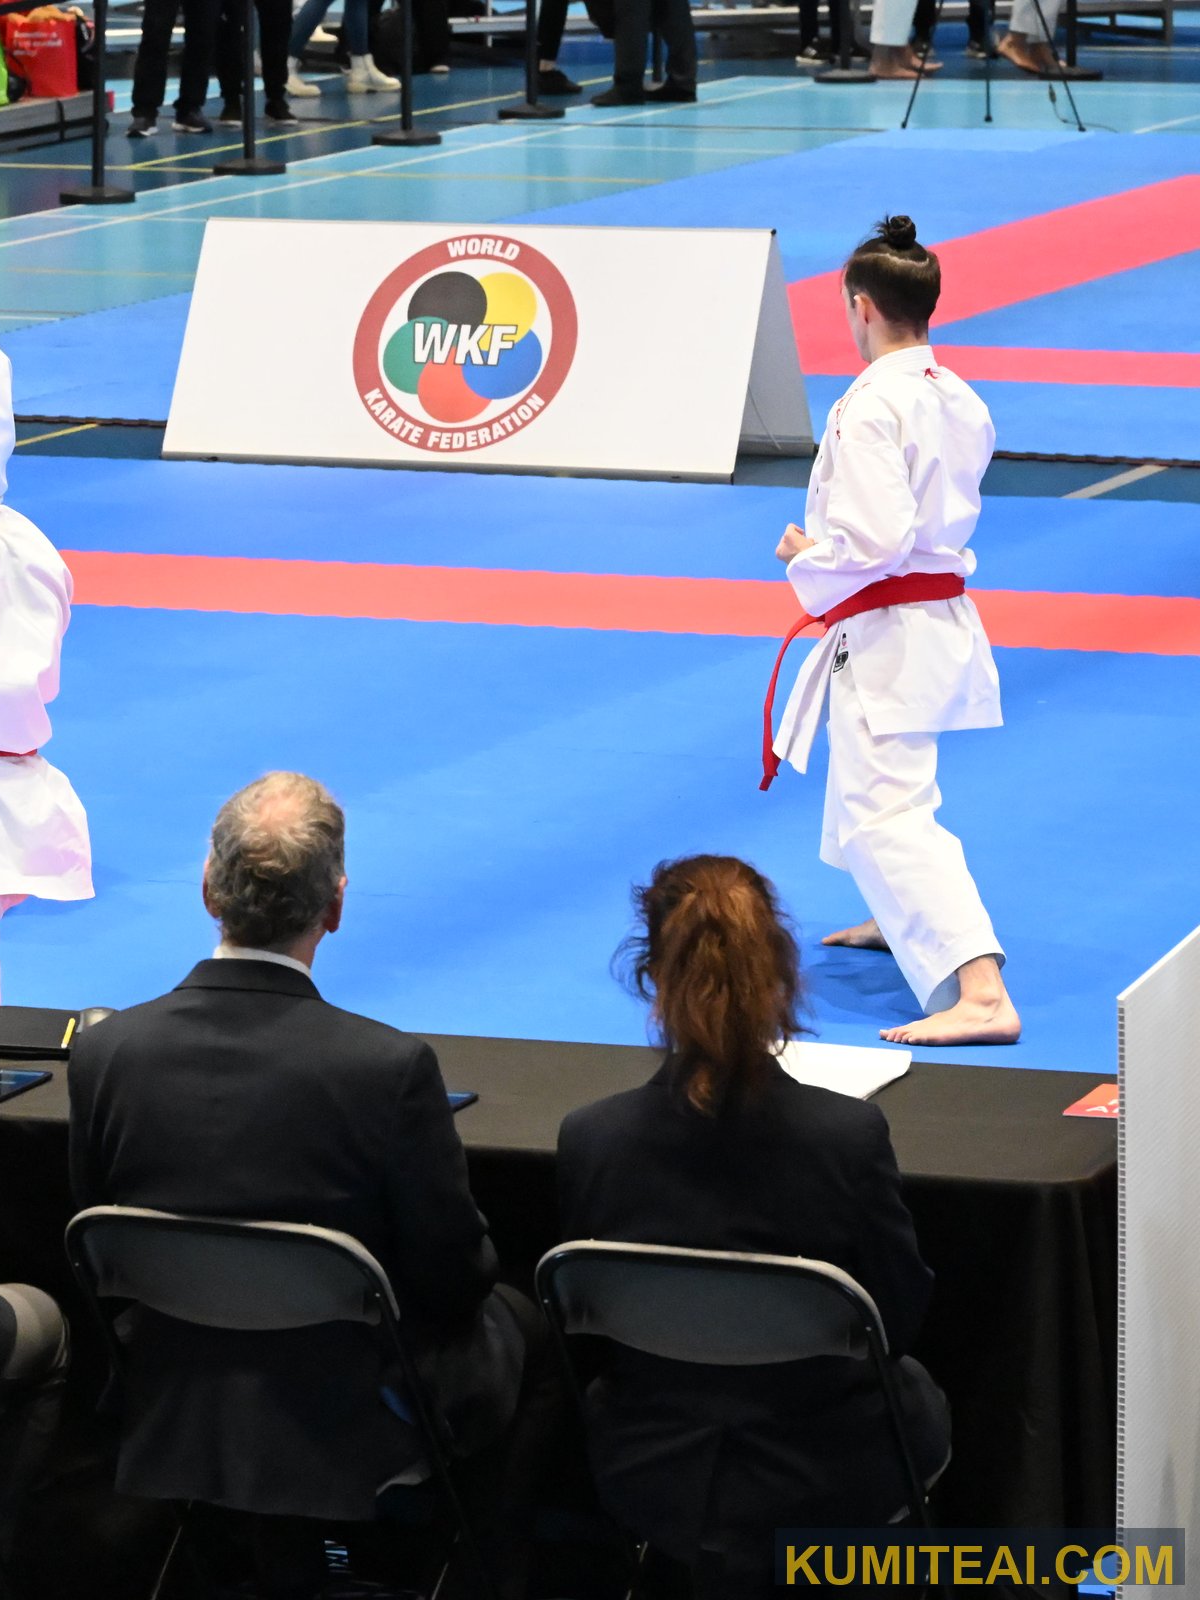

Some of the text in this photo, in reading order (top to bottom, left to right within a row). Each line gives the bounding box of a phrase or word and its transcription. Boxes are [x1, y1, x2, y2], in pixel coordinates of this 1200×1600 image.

[447, 238, 520, 261] WORLD
[413, 321, 518, 366] WKF
[364, 388, 545, 449] KARATE FEDERATION
